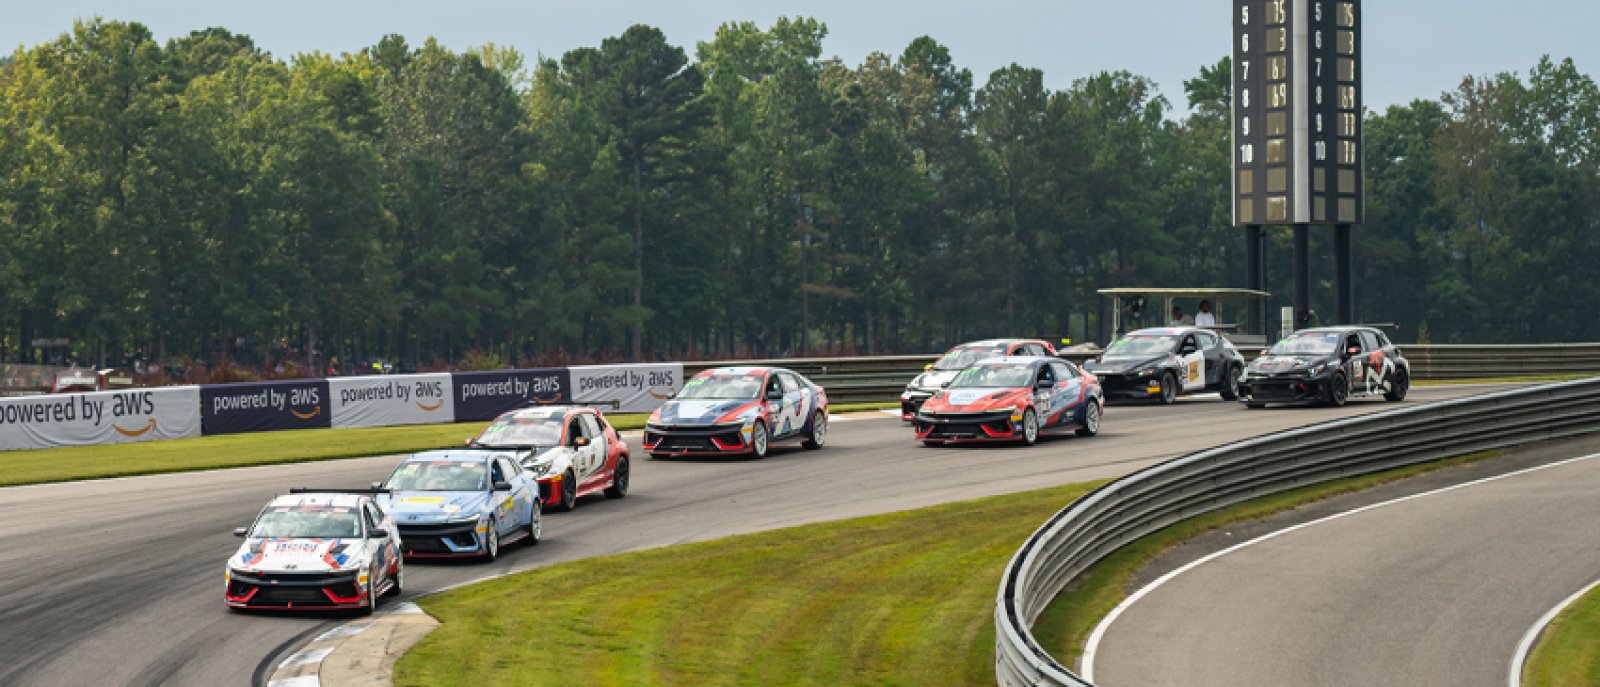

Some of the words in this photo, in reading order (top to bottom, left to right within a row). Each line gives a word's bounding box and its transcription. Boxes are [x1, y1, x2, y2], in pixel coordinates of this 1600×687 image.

[1242, 5, 1248, 25] 5
[1316, 2, 1322, 22] 5
[1242, 33, 1248, 52] 6
[1280, 27, 1286, 52] 3
[1242, 60, 1250, 81] 7
[1316, 58, 1322, 78] 7
[1242, 88, 1249, 108] 8
[1243, 116, 1250, 136] 9
[1240, 144, 1252, 163] 10
[1316, 140, 1326, 160] 10
[462, 377, 512, 402] powered
[514, 377, 529, 398] by
[533, 376, 560, 392] aws
[580, 370, 627, 390] powered
[630, 370, 644, 392] by
[649, 370, 673, 386] aws
[214, 388, 268, 414] powered
[270, 388, 286, 411] by
[291, 387, 319, 406] aws
[341, 382, 392, 406] powered
[395, 381, 411, 403] by
[416, 382, 442, 398] aws
[81, 395, 104, 426] by
[112, 391, 154, 416] aws
